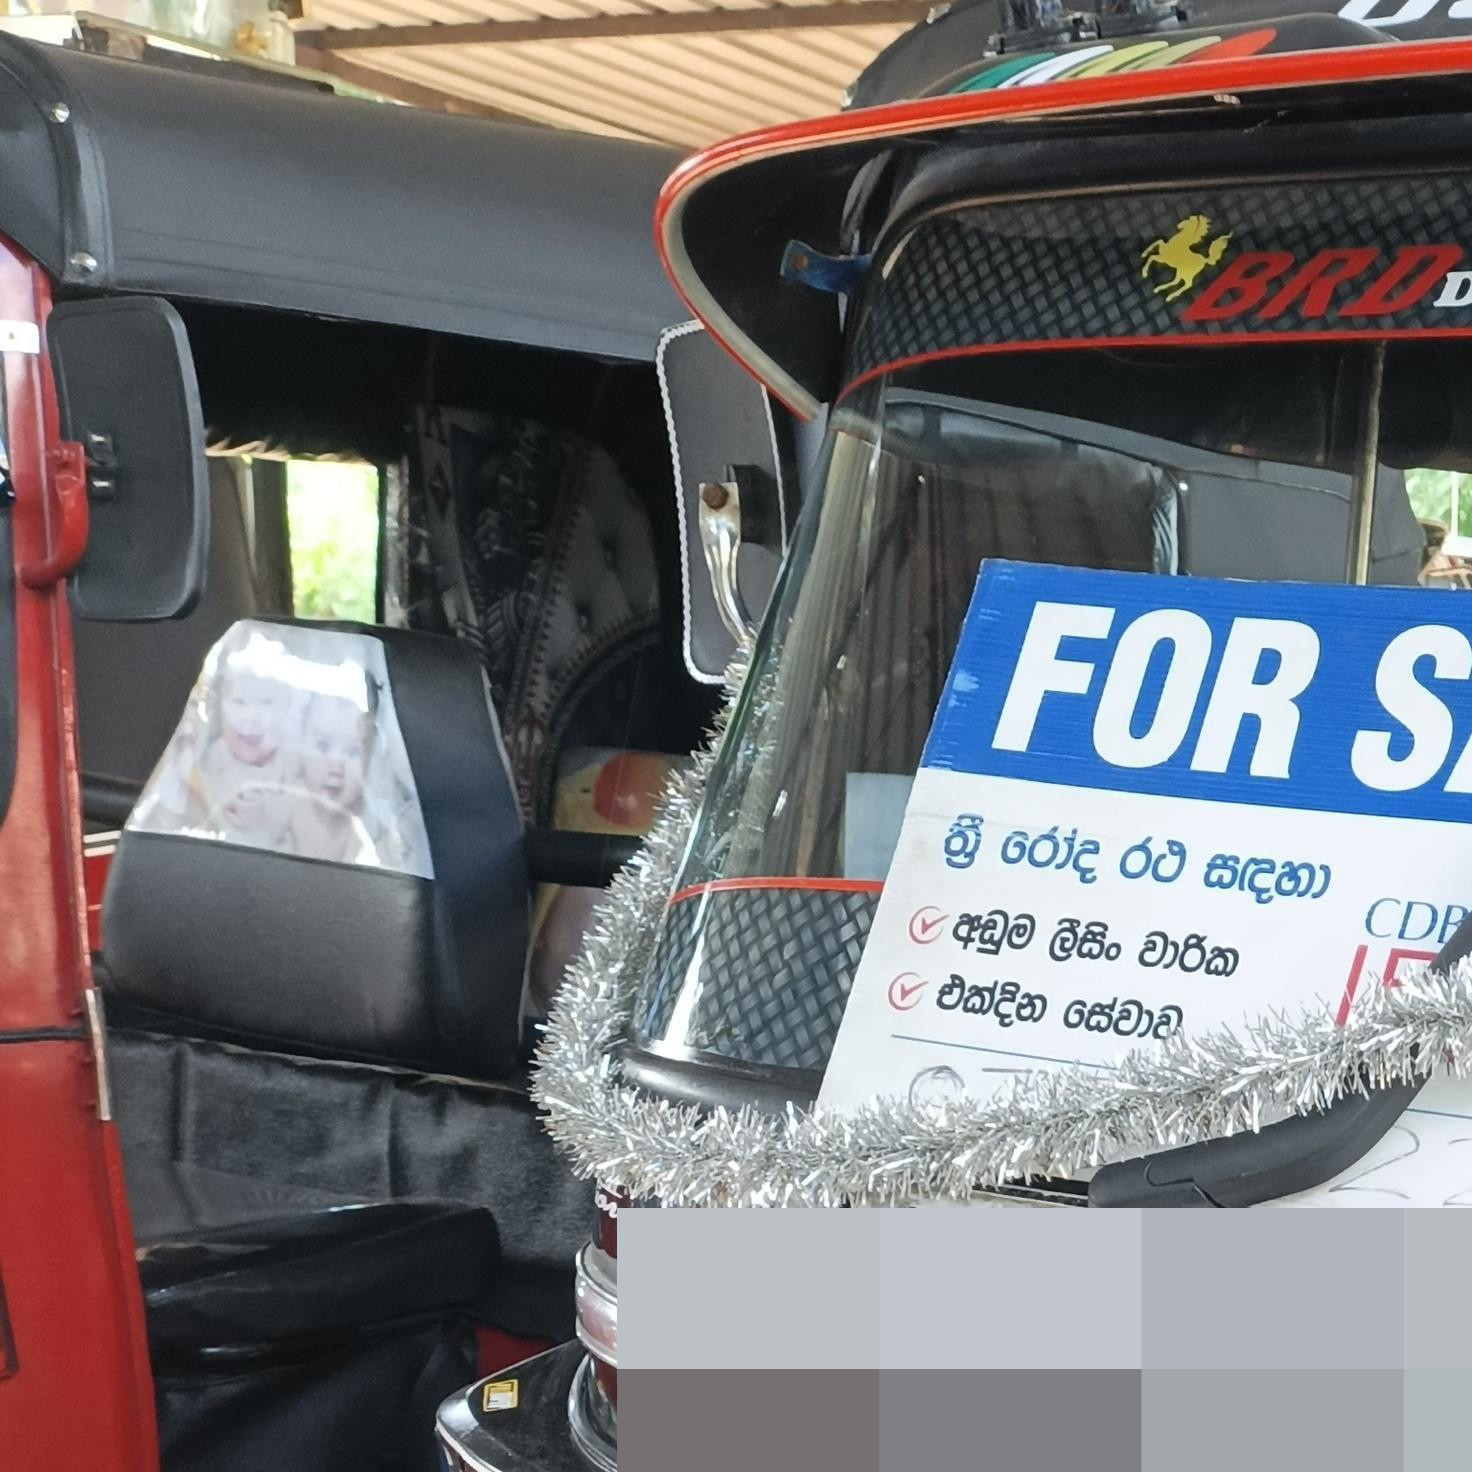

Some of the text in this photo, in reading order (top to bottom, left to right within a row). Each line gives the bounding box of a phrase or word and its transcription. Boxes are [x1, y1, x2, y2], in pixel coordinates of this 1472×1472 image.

[1182, 244, 1464, 321] BRD
[992, 601, 1323, 779] FOR
[1119, 835, 1187, 883] රථ
[1202, 852, 1332, 905] සඳහා
[951, 909, 1037, 956] අඩුම
[1137, 930, 1240, 978] වාරික
